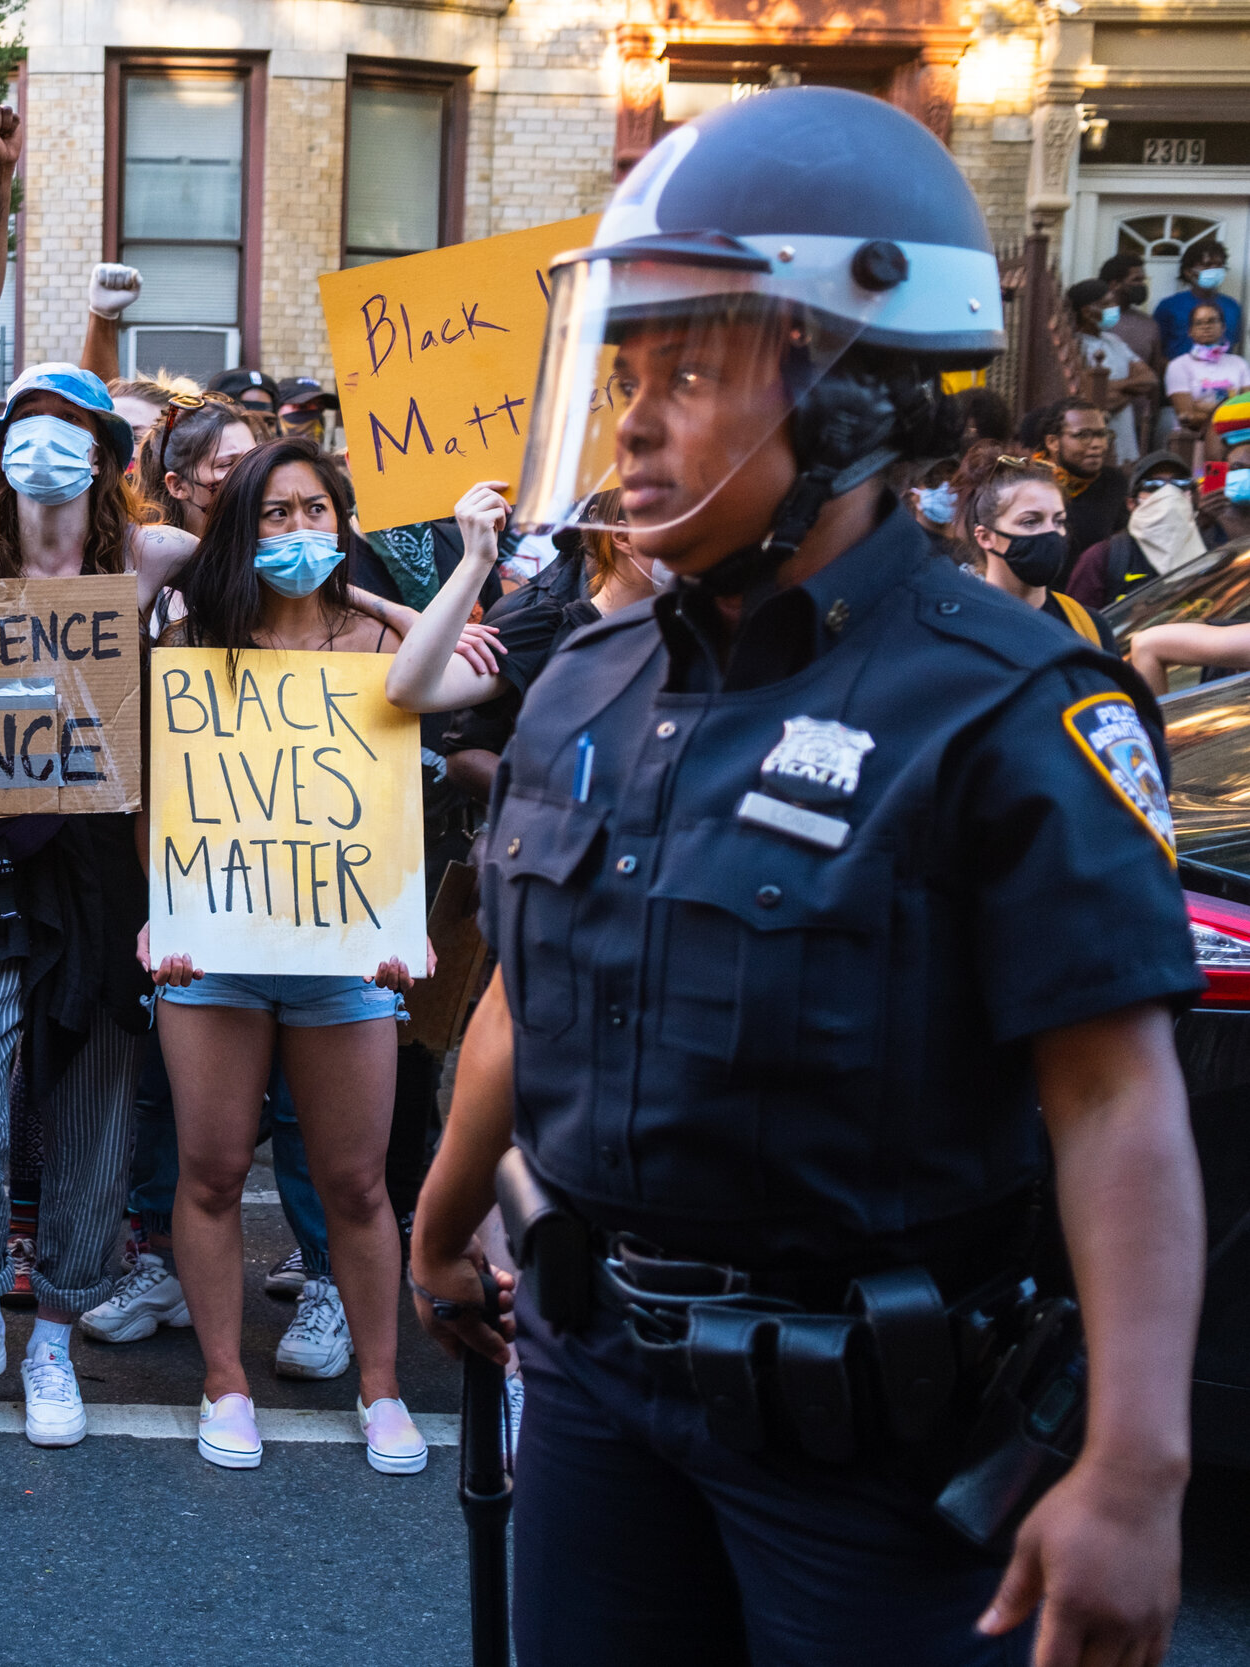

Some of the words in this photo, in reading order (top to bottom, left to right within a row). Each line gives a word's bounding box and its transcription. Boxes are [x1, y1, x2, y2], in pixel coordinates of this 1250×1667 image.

[1147, 140, 1202, 163] 2309
[360, 293, 510, 378] Black
[162, 667, 378, 761] BLACK
[184, 745, 362, 830] LIVES
[164, 835, 382, 929] MATTER
